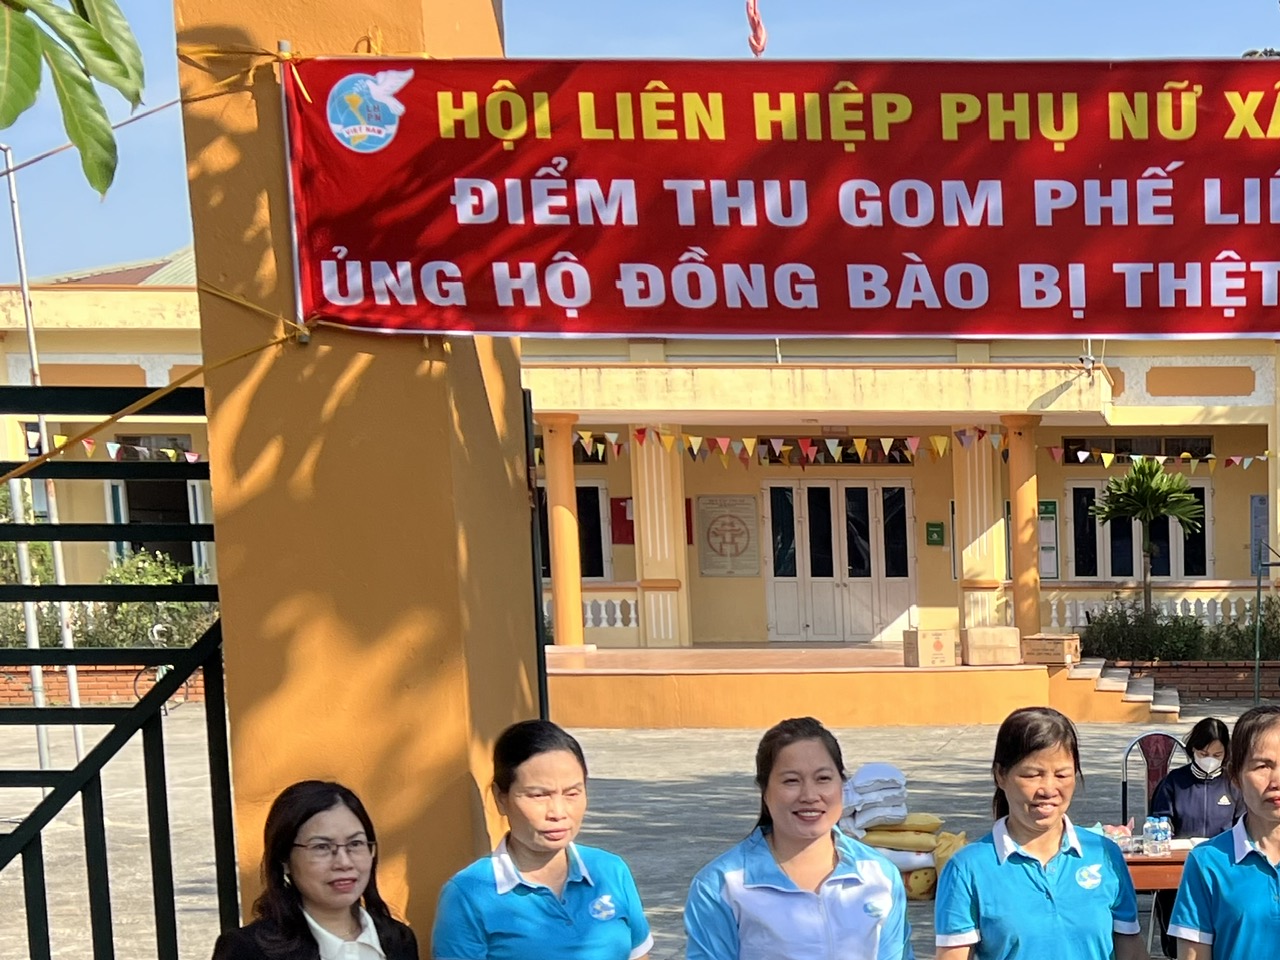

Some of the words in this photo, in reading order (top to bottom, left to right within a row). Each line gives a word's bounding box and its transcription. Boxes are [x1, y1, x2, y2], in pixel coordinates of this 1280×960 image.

[436, 79, 551, 150] HỘI
[578, 80, 725, 140] LIÊN
[752, 80, 913, 152] HIỆP
[940, 92, 1079, 152] PHỤ
[1108, 80, 1203, 140] NỮ
[450, 156, 638, 226] ĐIỂM
[663, 179, 808, 227] THU
[838, 179, 1003, 227] GOM
[1034, 160, 1184, 226] PHẾ
[320, 245, 467, 306] ỦNG
[492, 251, 592, 318] HỘ
[615, 246, 819, 309] ĐỒNG
[847, 252, 988, 309] BÀO
[1018, 264, 1085, 319] BỊ
